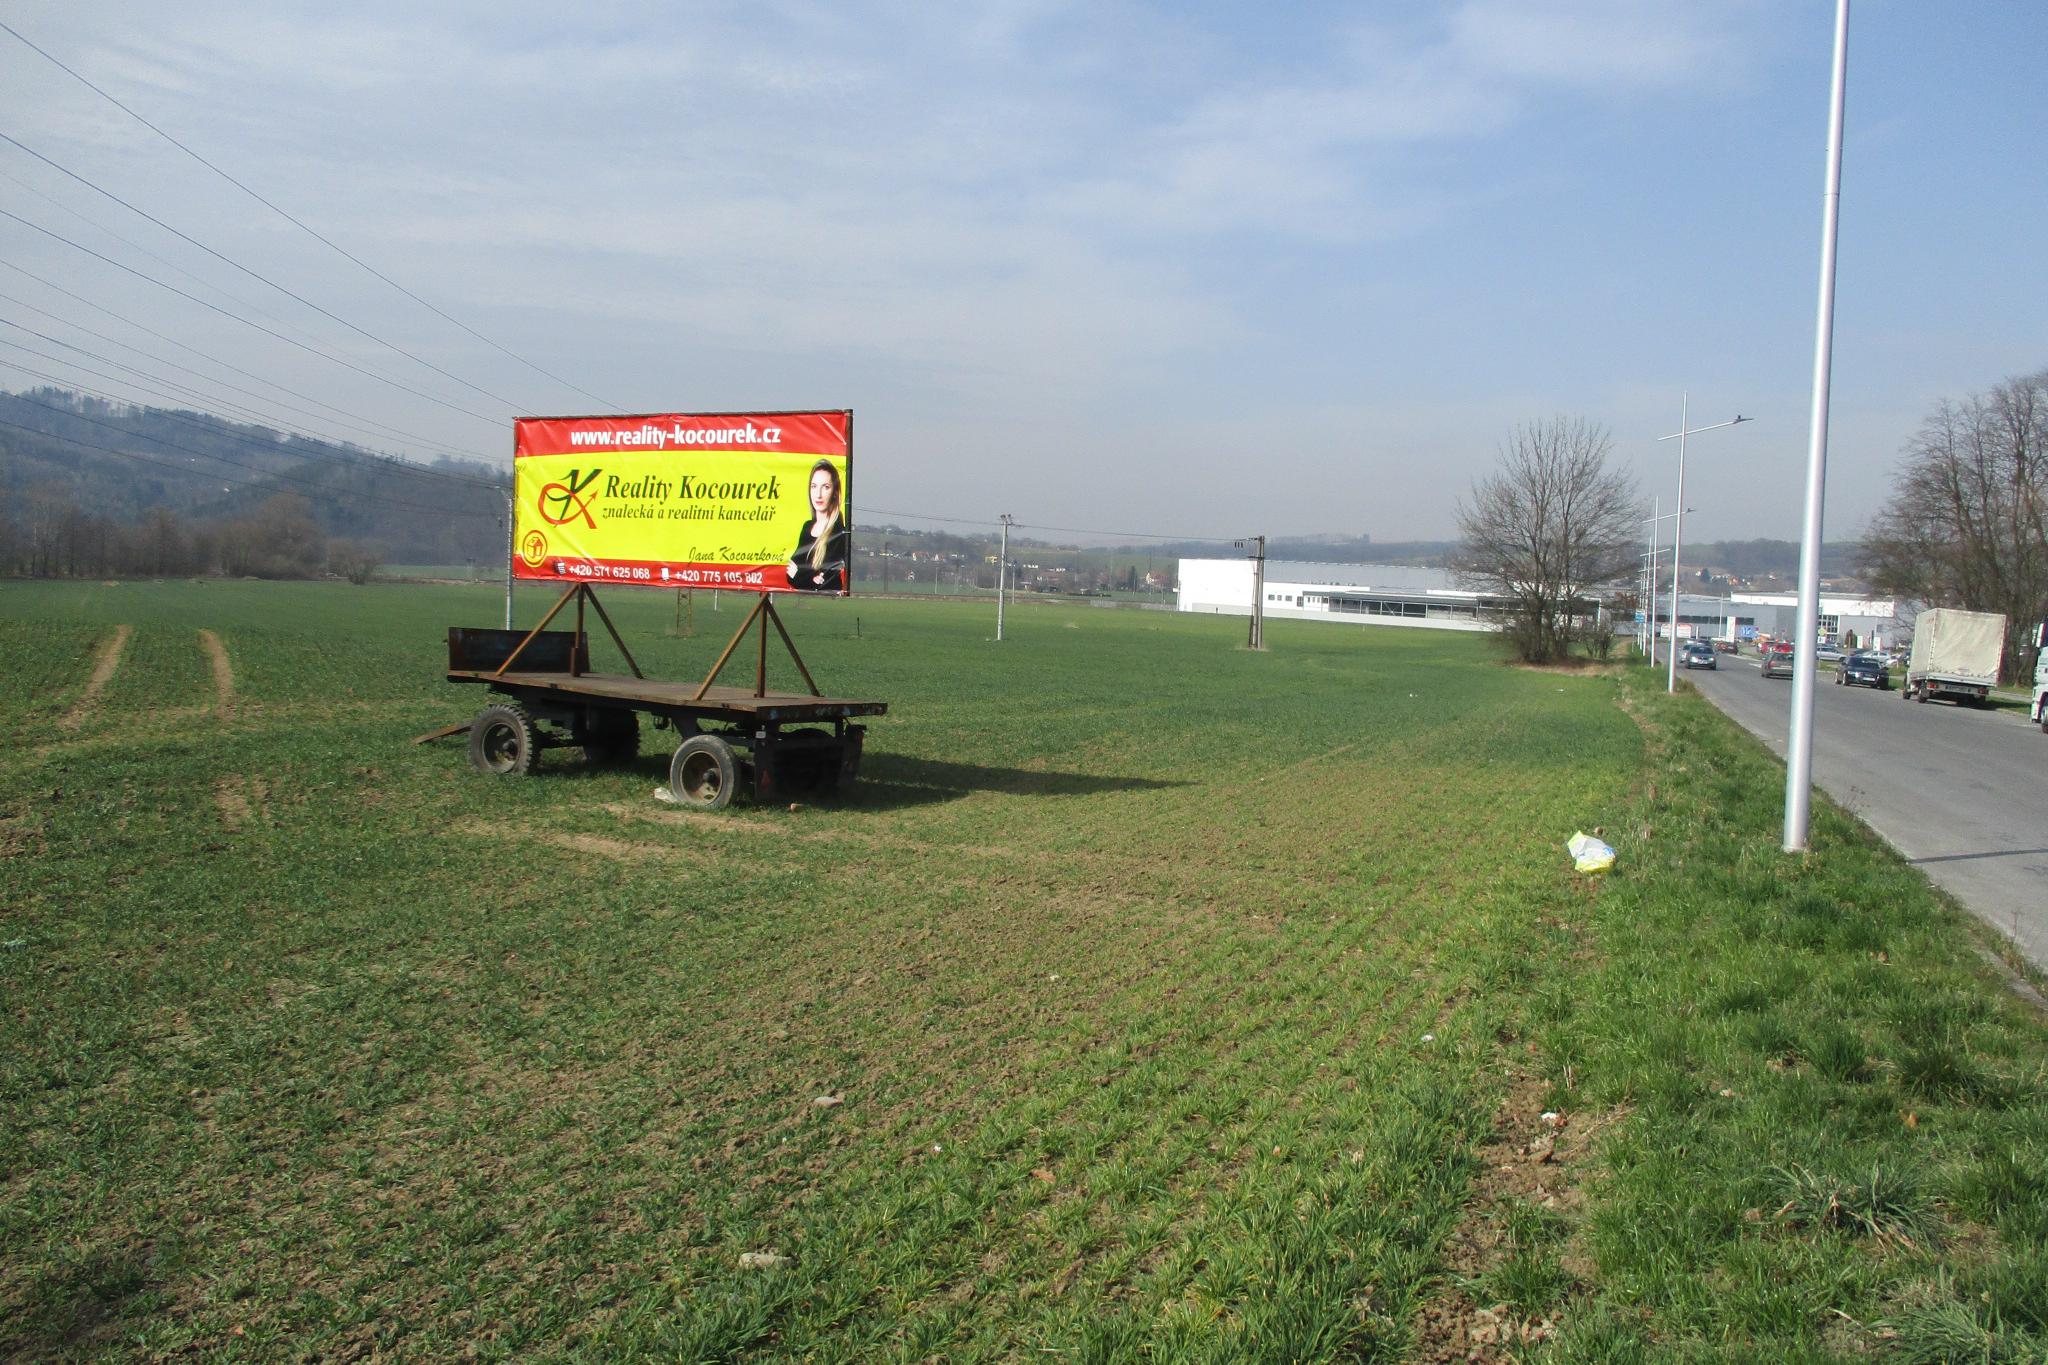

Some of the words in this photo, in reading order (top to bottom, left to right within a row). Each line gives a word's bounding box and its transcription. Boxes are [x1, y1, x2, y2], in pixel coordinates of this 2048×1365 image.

[571, 423, 782, 449] www.reality-kocourek.cz
[605, 475, 672, 505] Reality
[679, 475, 782, 500] Kocourek
[603, 504, 654, 519] znalecká
[658, 509, 664, 519] a
[667, 504, 715, 520] realitní
[718, 505, 776, 521] kancelář
[688, 547, 714, 564] Jana
[719, 546, 787, 562] Kocourková
[569, 565, 592, 576] +420
[594, 566, 610, 577] 571
[613, 567, 630, 578] 625
[632, 568, 650, 579] 068
[675, 570, 700, 582] +420
[703, 571, 721, 582] 775
[724, 572, 743, 583] 105
